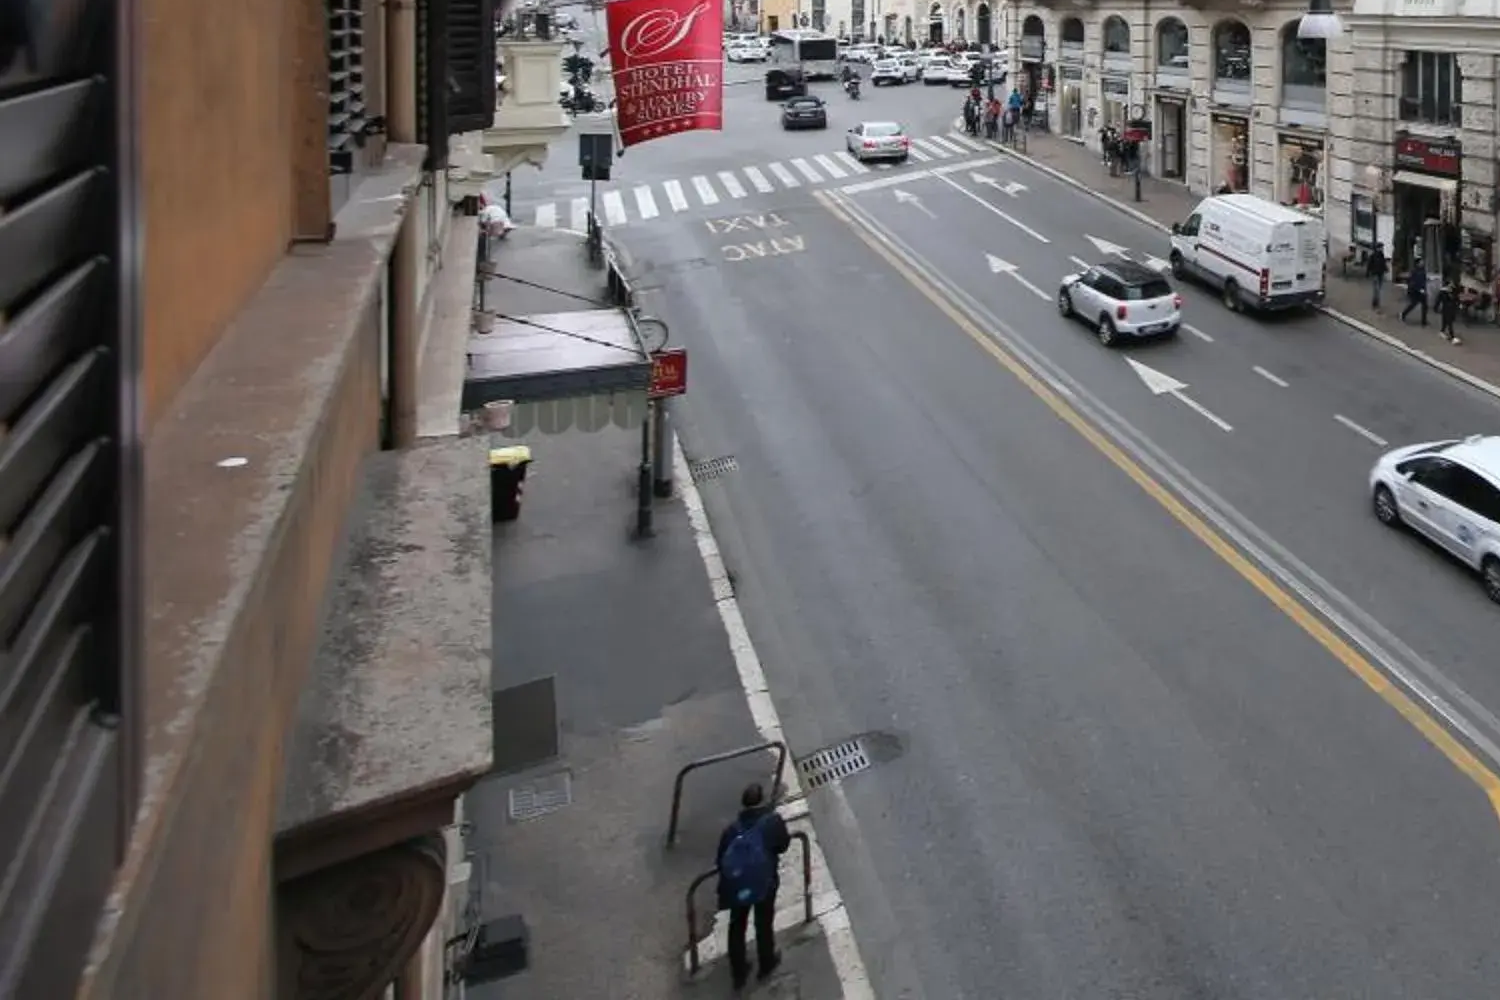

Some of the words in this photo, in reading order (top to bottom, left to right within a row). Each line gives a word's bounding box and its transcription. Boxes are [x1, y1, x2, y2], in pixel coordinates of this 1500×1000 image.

[631, 63, 699, 82] HOTEL
[620, 73, 716, 101] STENDHAL
[637, 101, 697, 122] SUITES
[639, 90, 709, 113] LUXURY
[704, 211, 789, 234] TAXI
